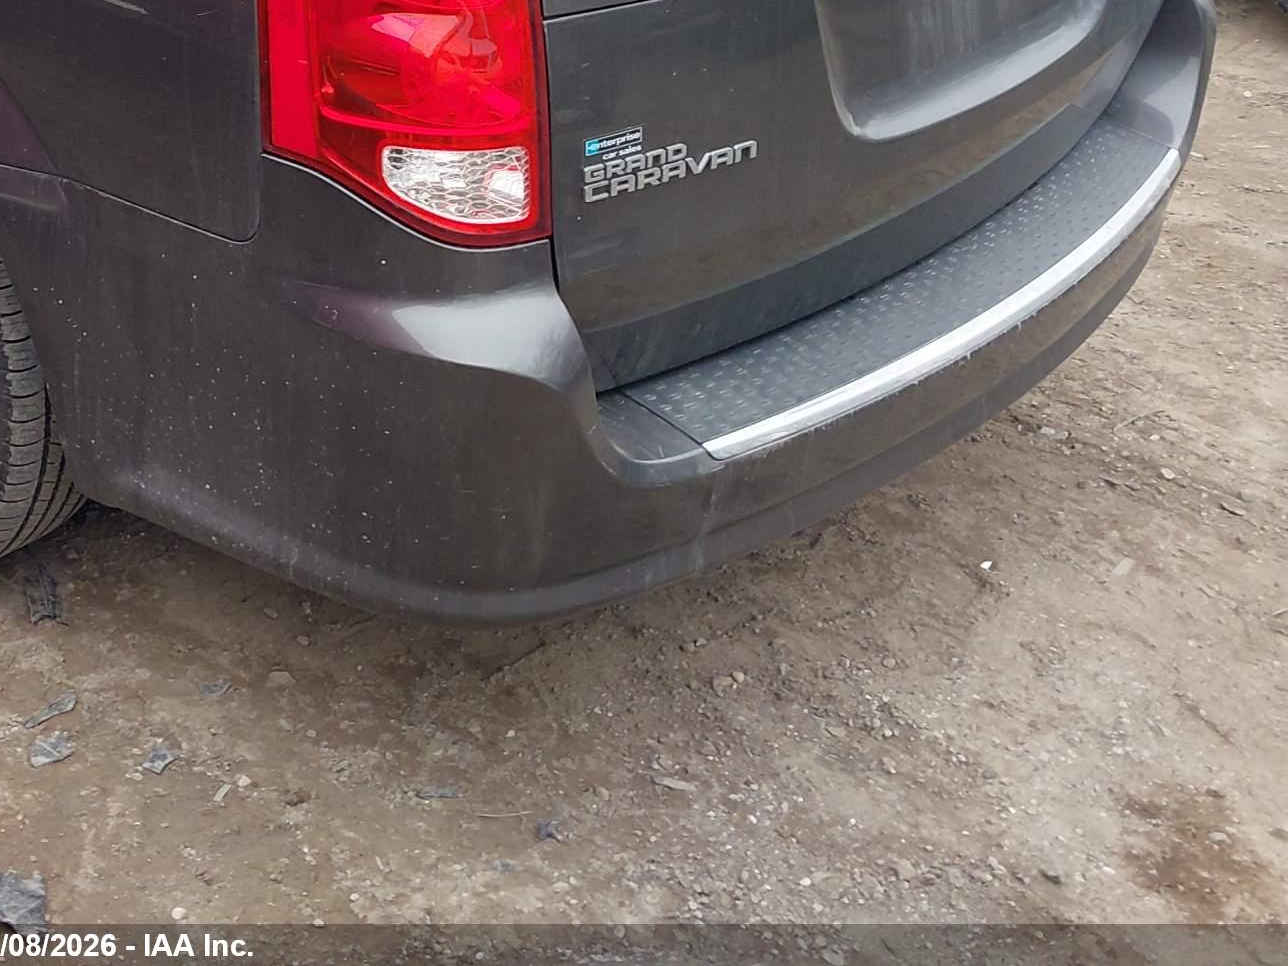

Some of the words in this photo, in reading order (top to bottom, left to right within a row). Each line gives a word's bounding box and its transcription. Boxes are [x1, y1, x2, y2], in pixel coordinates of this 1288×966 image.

[588, 132, 642, 151] enterprise
[602, 151, 618, 160] car
[618, 145, 642, 156] sales
[583, 143, 688, 184] GRAND
[583, 139, 758, 203] CARAVAN
